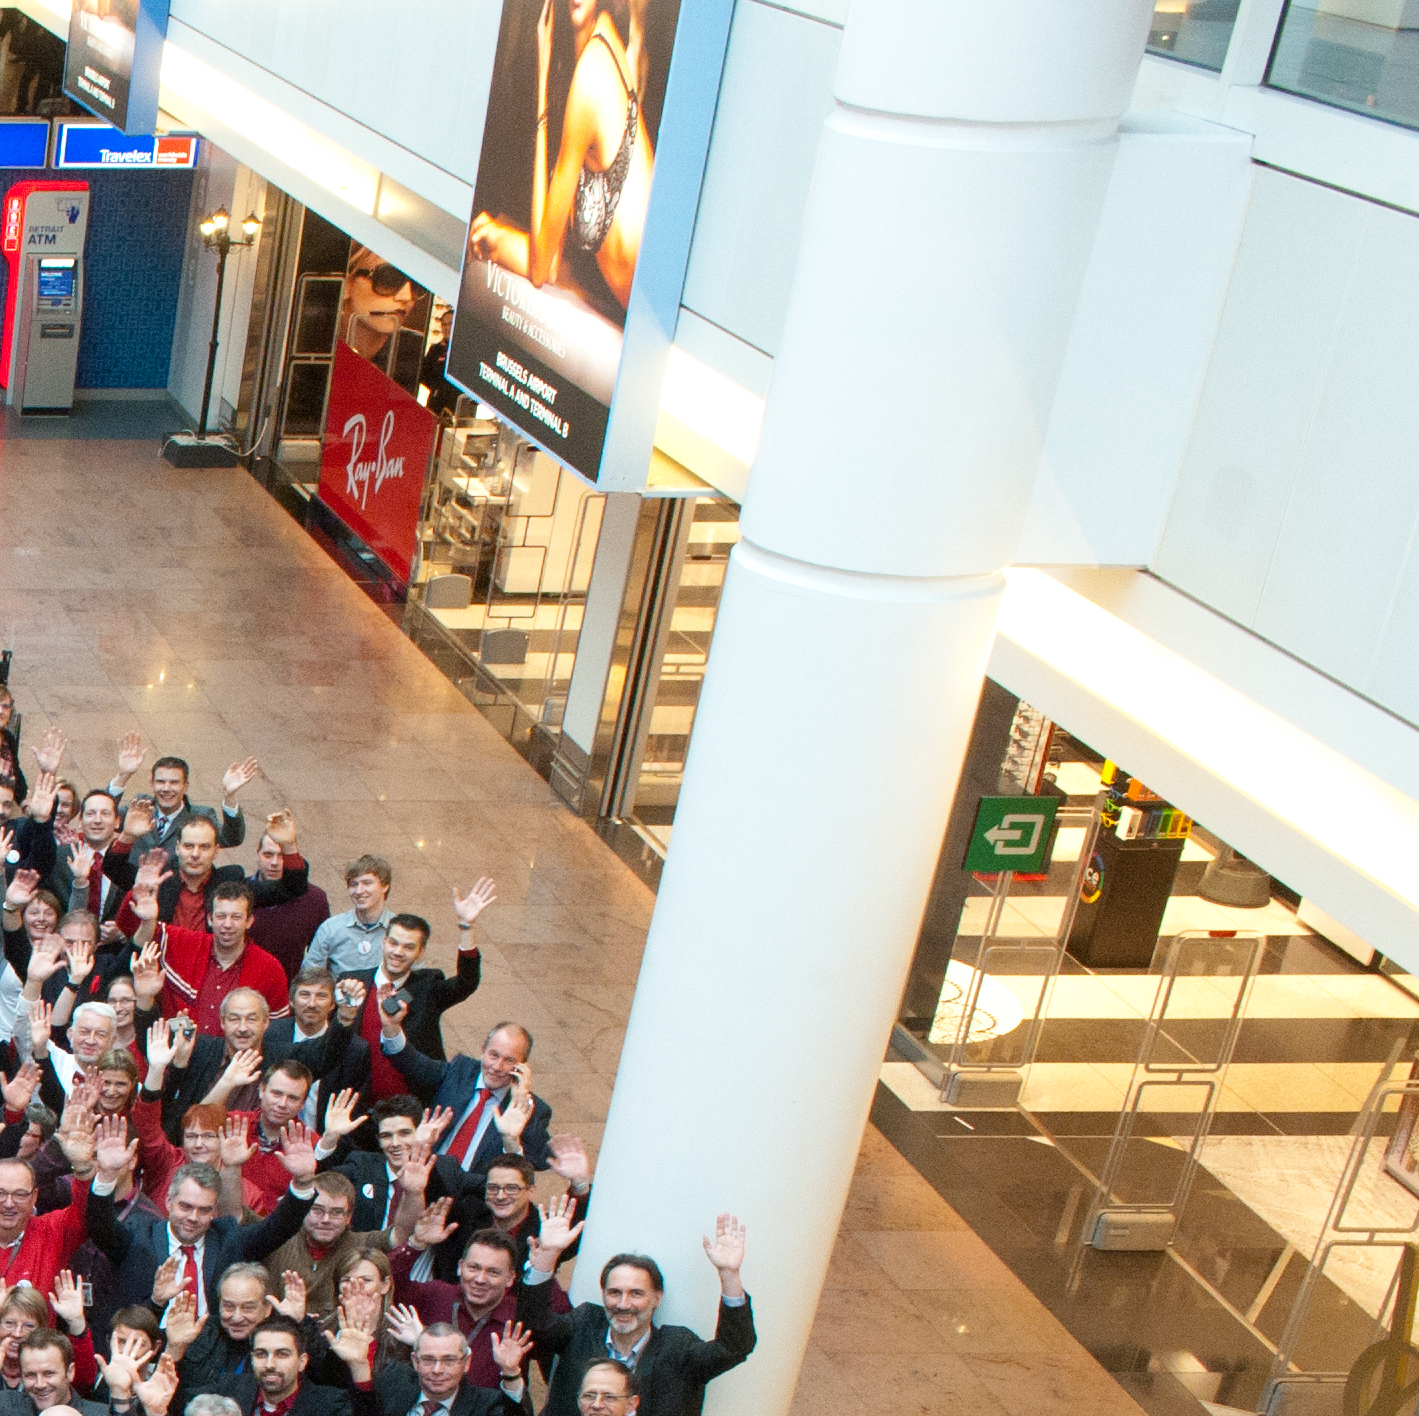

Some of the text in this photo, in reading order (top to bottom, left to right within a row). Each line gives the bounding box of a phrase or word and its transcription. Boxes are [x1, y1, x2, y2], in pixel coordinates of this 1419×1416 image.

[100, 149, 151, 162] Travelex
[28, 234, 57, 245] ATM
[501, 305, 523, 330] BEAUTY
[496, 351, 558, 405] BRUSSELS AIRPORT
[479, 361, 570, 438] TERMINAL A AND TERMINAL B
